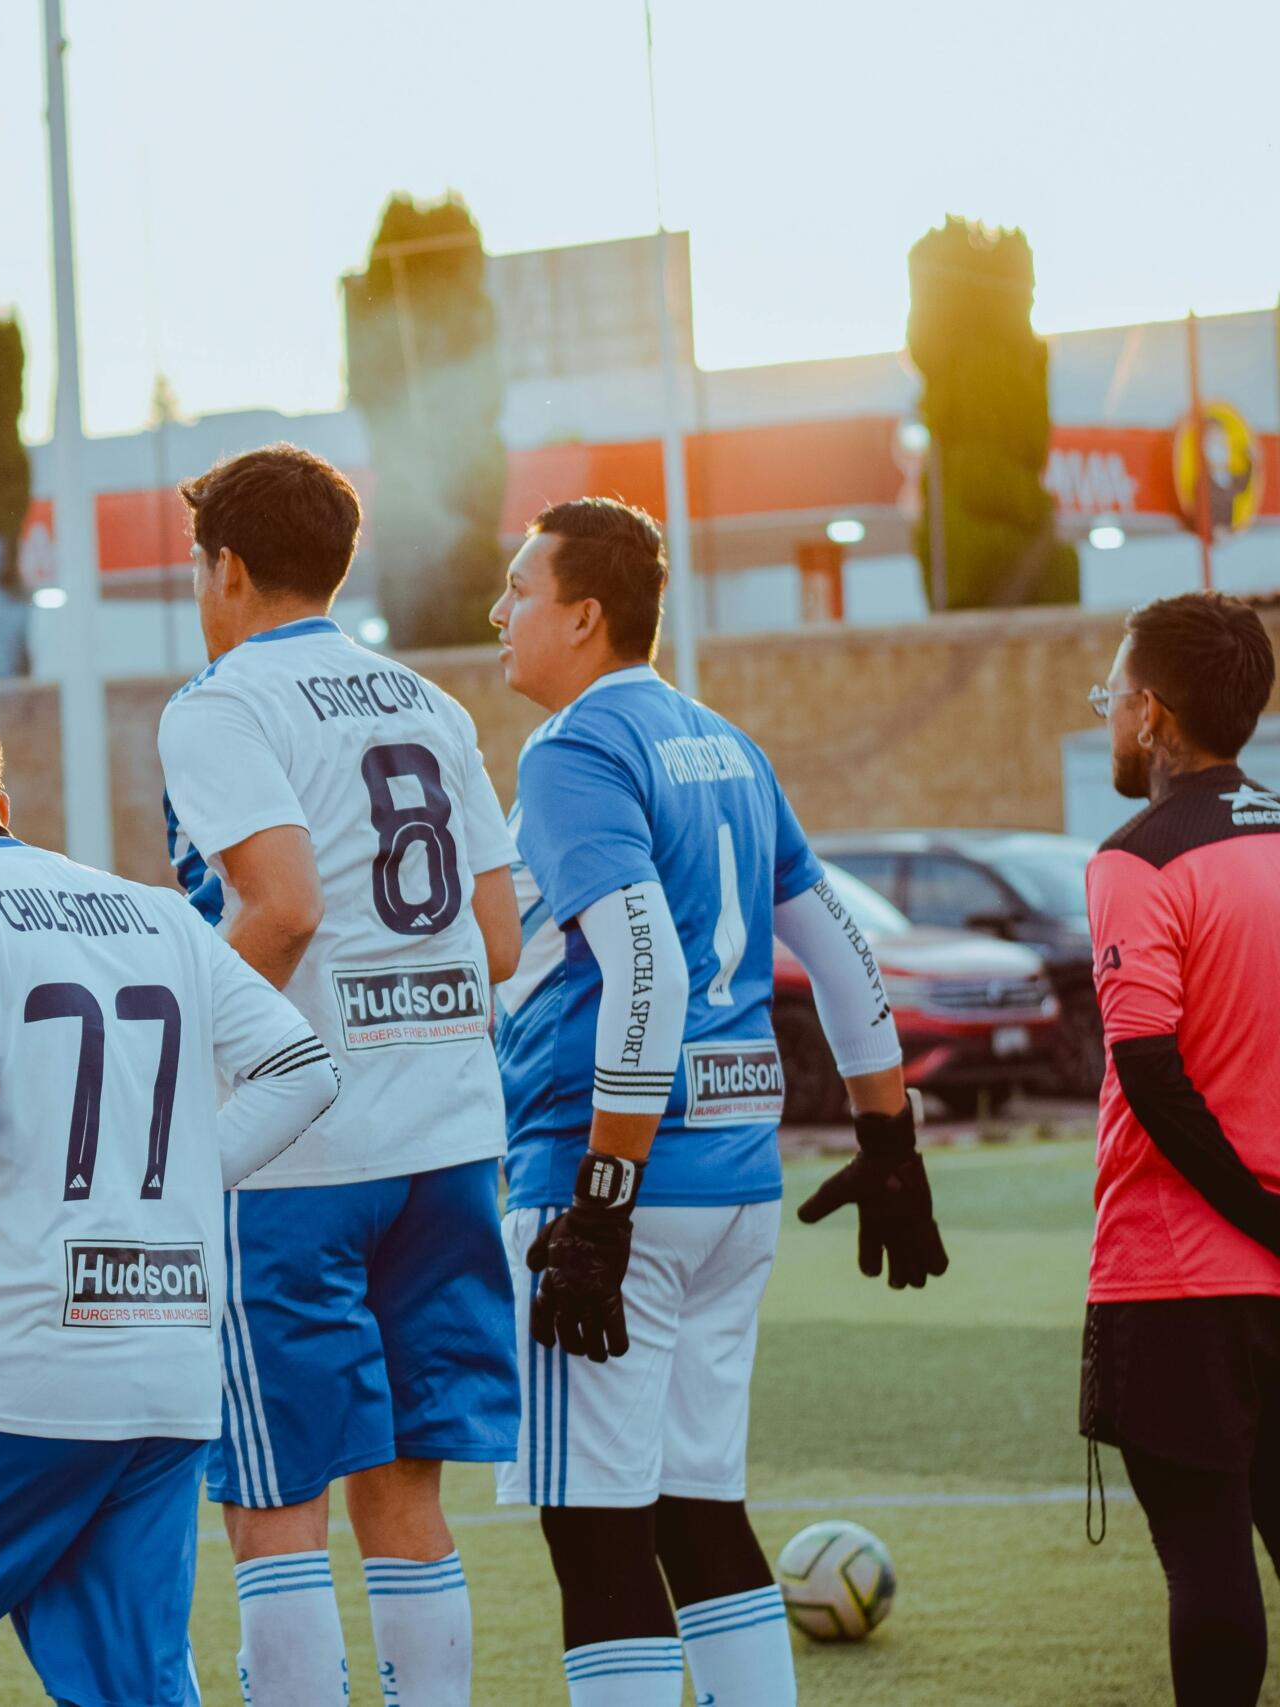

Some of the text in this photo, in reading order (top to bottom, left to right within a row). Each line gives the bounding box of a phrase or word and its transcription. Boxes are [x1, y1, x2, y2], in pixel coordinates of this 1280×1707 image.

[361, 742, 462, 935] 8
[707, 822, 748, 1006] 1
[812, 877, 847, 920] SPOR
[342, 976, 480, 1020] Hudson
[620, 894, 653, 1067] LA BOCHA SPORT
[24, 982, 181, 1201] 77
[696, 1055, 781, 1095] Hudson
[74, 1254, 204, 1296] Hudson
[70, 1308, 208, 1320] BURGERS FRIES MUNCHIES
